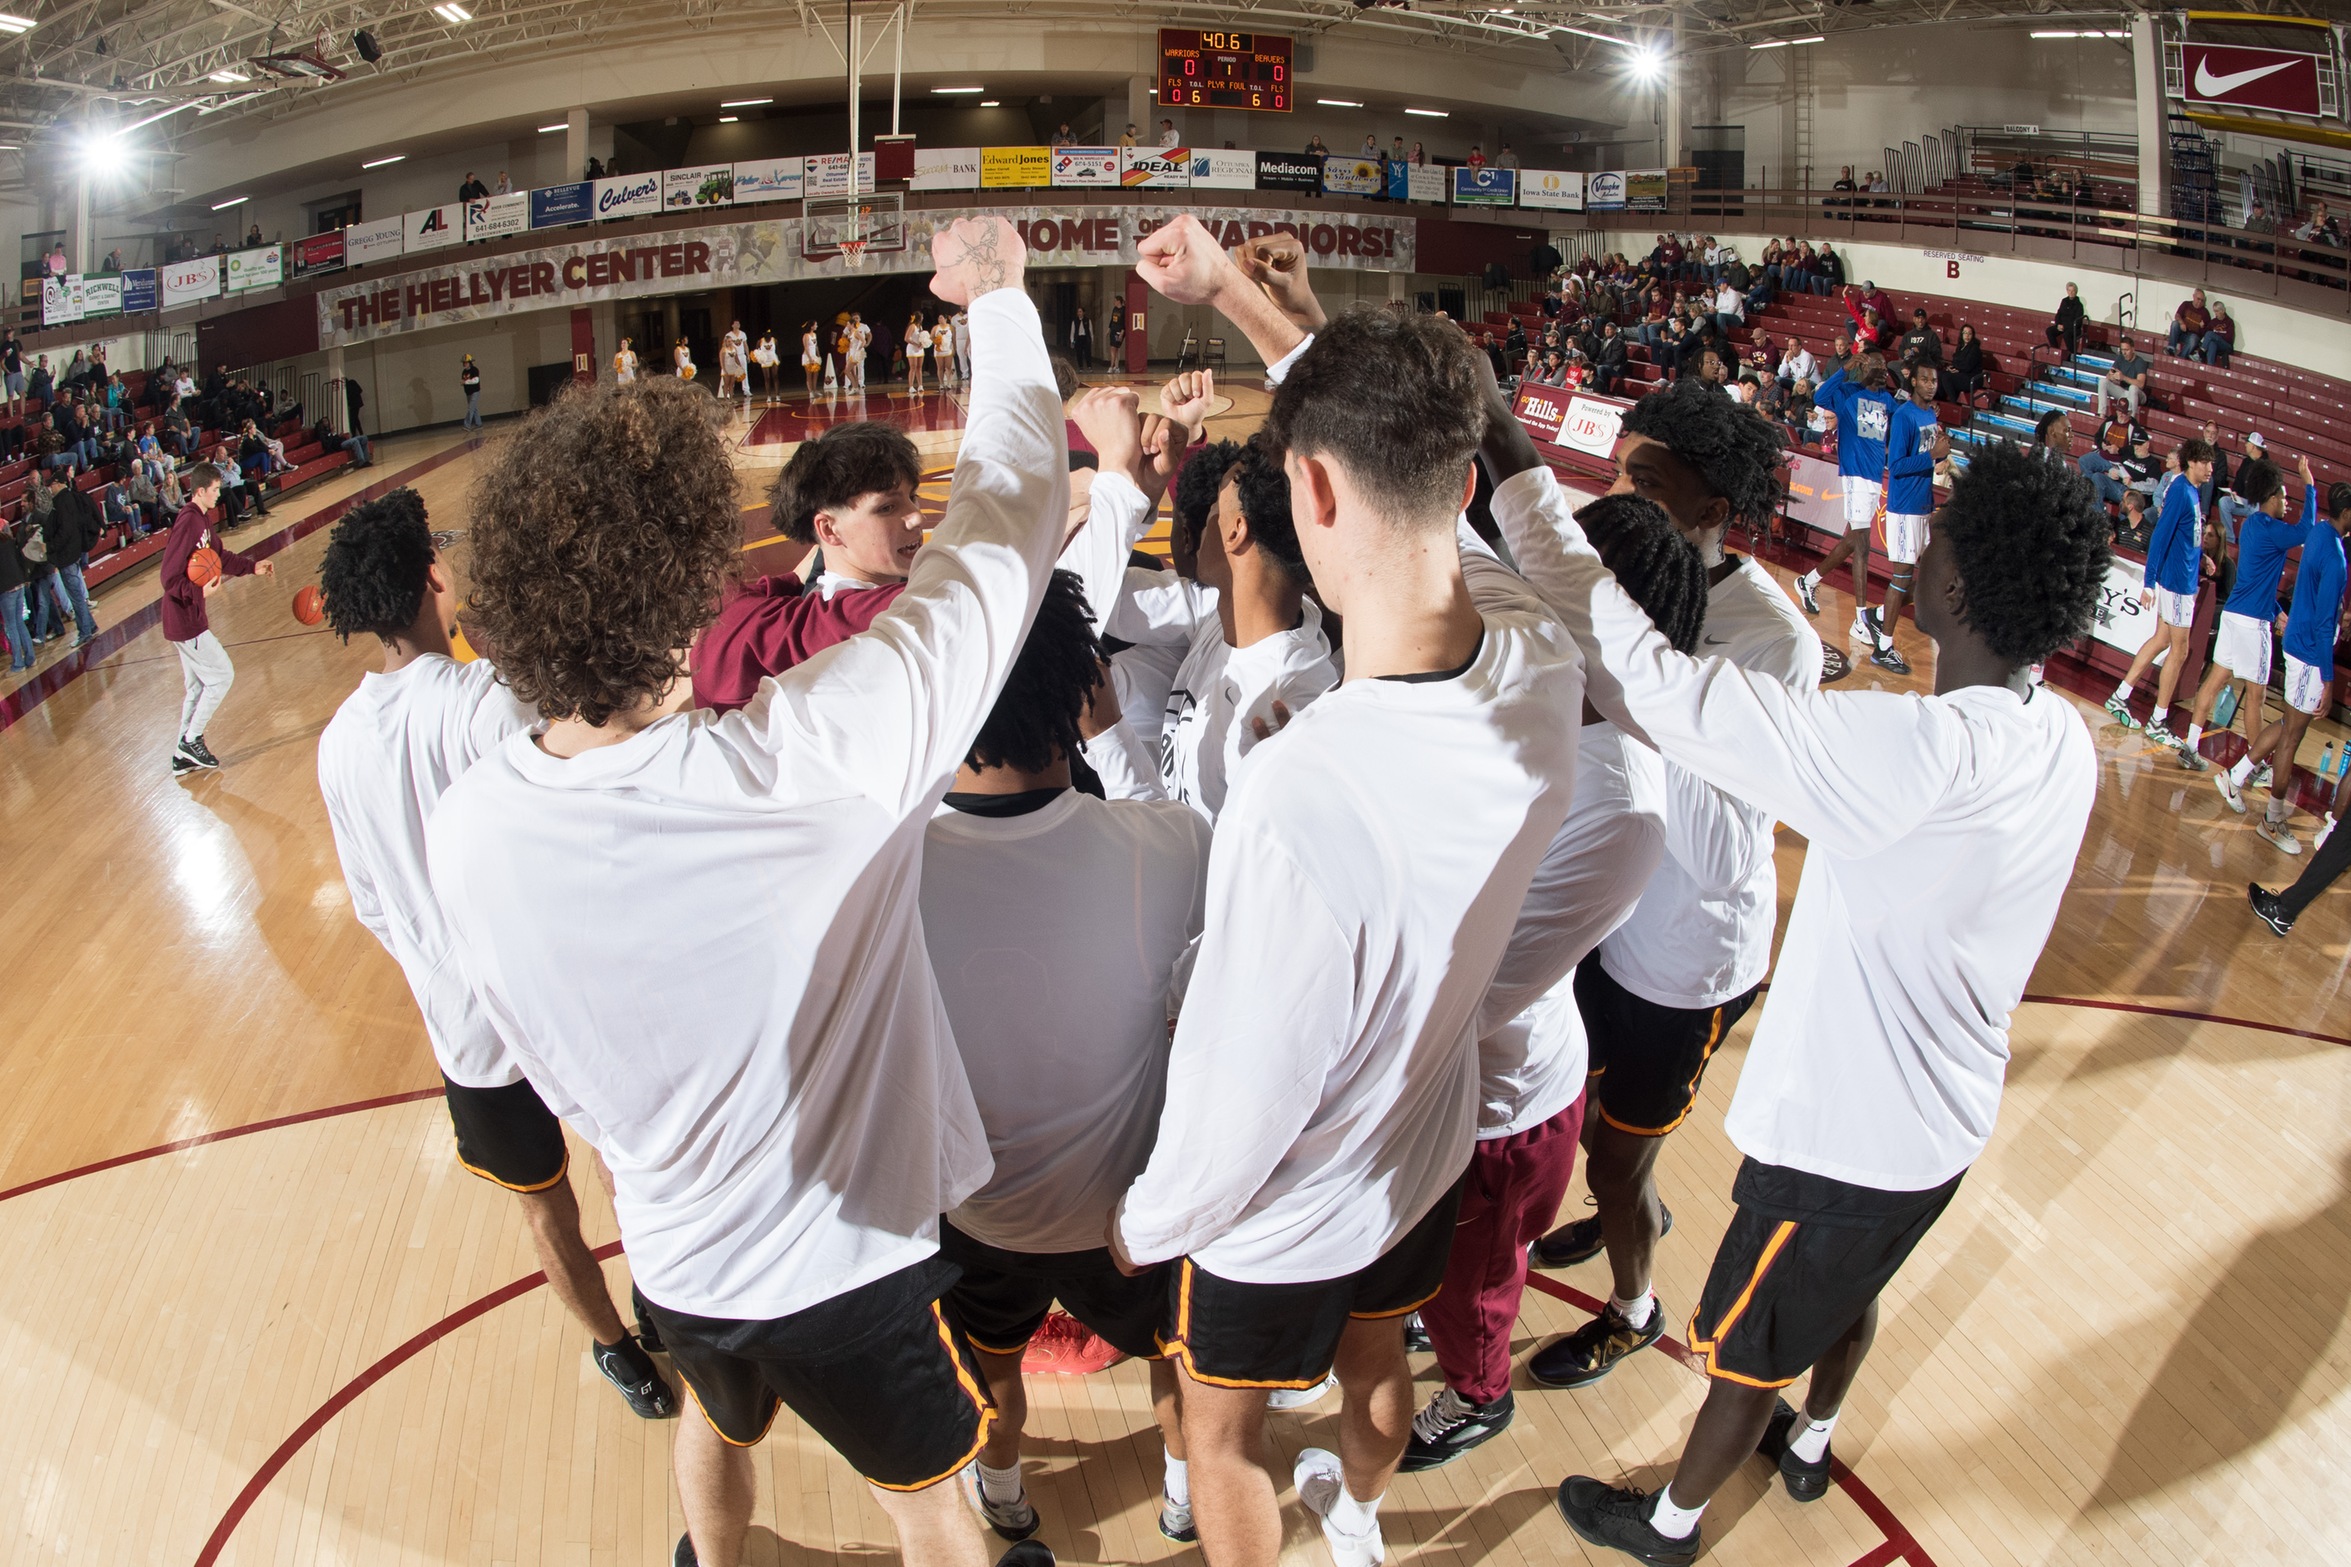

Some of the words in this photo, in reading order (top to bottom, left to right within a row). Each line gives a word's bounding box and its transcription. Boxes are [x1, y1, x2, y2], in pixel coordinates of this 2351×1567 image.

[1203, 32, 1240, 50] 40.6
[1164, 48, 1200, 58] WARRIORS
[1254, 54, 1285, 64] BEAVERS
[1184, 59, 1195, 76] 0
[1227, 64, 1231, 76] 1
[1273, 65, 1284, 82] 0
[1167, 78, 1182, 87] FLS
[1229, 81, 1247, 91] FOUL
[1270, 84, 1284, 93] FLS
[1172, 89, 1181, 102] 0
[1192, 90, 1201, 103] 6
[1252, 93, 1261, 107] 6
[1275, 95, 1283, 108] 0
[2005, 125, 2030, 133] BALCONY
[820, 156, 849, 165] RE/MA
[983, 154, 1018, 165] Edward
[1019, 154, 1049, 165] Jones
[1131, 160, 1183, 172] IDEAL
[1215, 160, 1250, 168] OTTUMWA
[953, 164, 977, 173] BANK
[1211, 166, 1254, 175] REGIONAL
[1260, 161, 1318, 175] Mediacom
[669, 171, 702, 182] SINCLAIR
[553, 184, 580, 194] BELLEVUE
[1595, 177, 1620, 193] Vaughn
[599, 177, 658, 213] Culver's
[1523, 188, 1540, 196] Iowa
[1541, 189, 1560, 198] State
[1561, 190, 1580, 199] Bank
[544, 202, 580, 212] Accelerate.
[475, 218, 519, 233] 641-684-6302
[348, 235, 374, 247] GREGG
[375, 229, 401, 241] YOUNG
[1009, 218, 1119, 252] HOME
[1923, 250, 1956, 260] RESERVED
[1958, 253, 1985, 263] SEATING
[1947, 260, 1960, 279] B
[174, 270, 208, 288] JBS
[338, 288, 400, 330] THE
[406, 262, 556, 317] HELLYER
[562, 241, 711, 290] CENTER
[85, 282, 120, 298] RICHWELL
[1524, 397, 1559, 421] Hills
[1555, 414, 1564, 423] TV
[1581, 402, 1602, 416] Powered
[1602, 409, 1613, 418] by
[1538, 421, 1546, 430] App
[1572, 418, 1606, 439] JBS
[641, 1381, 653, 1396] GT
